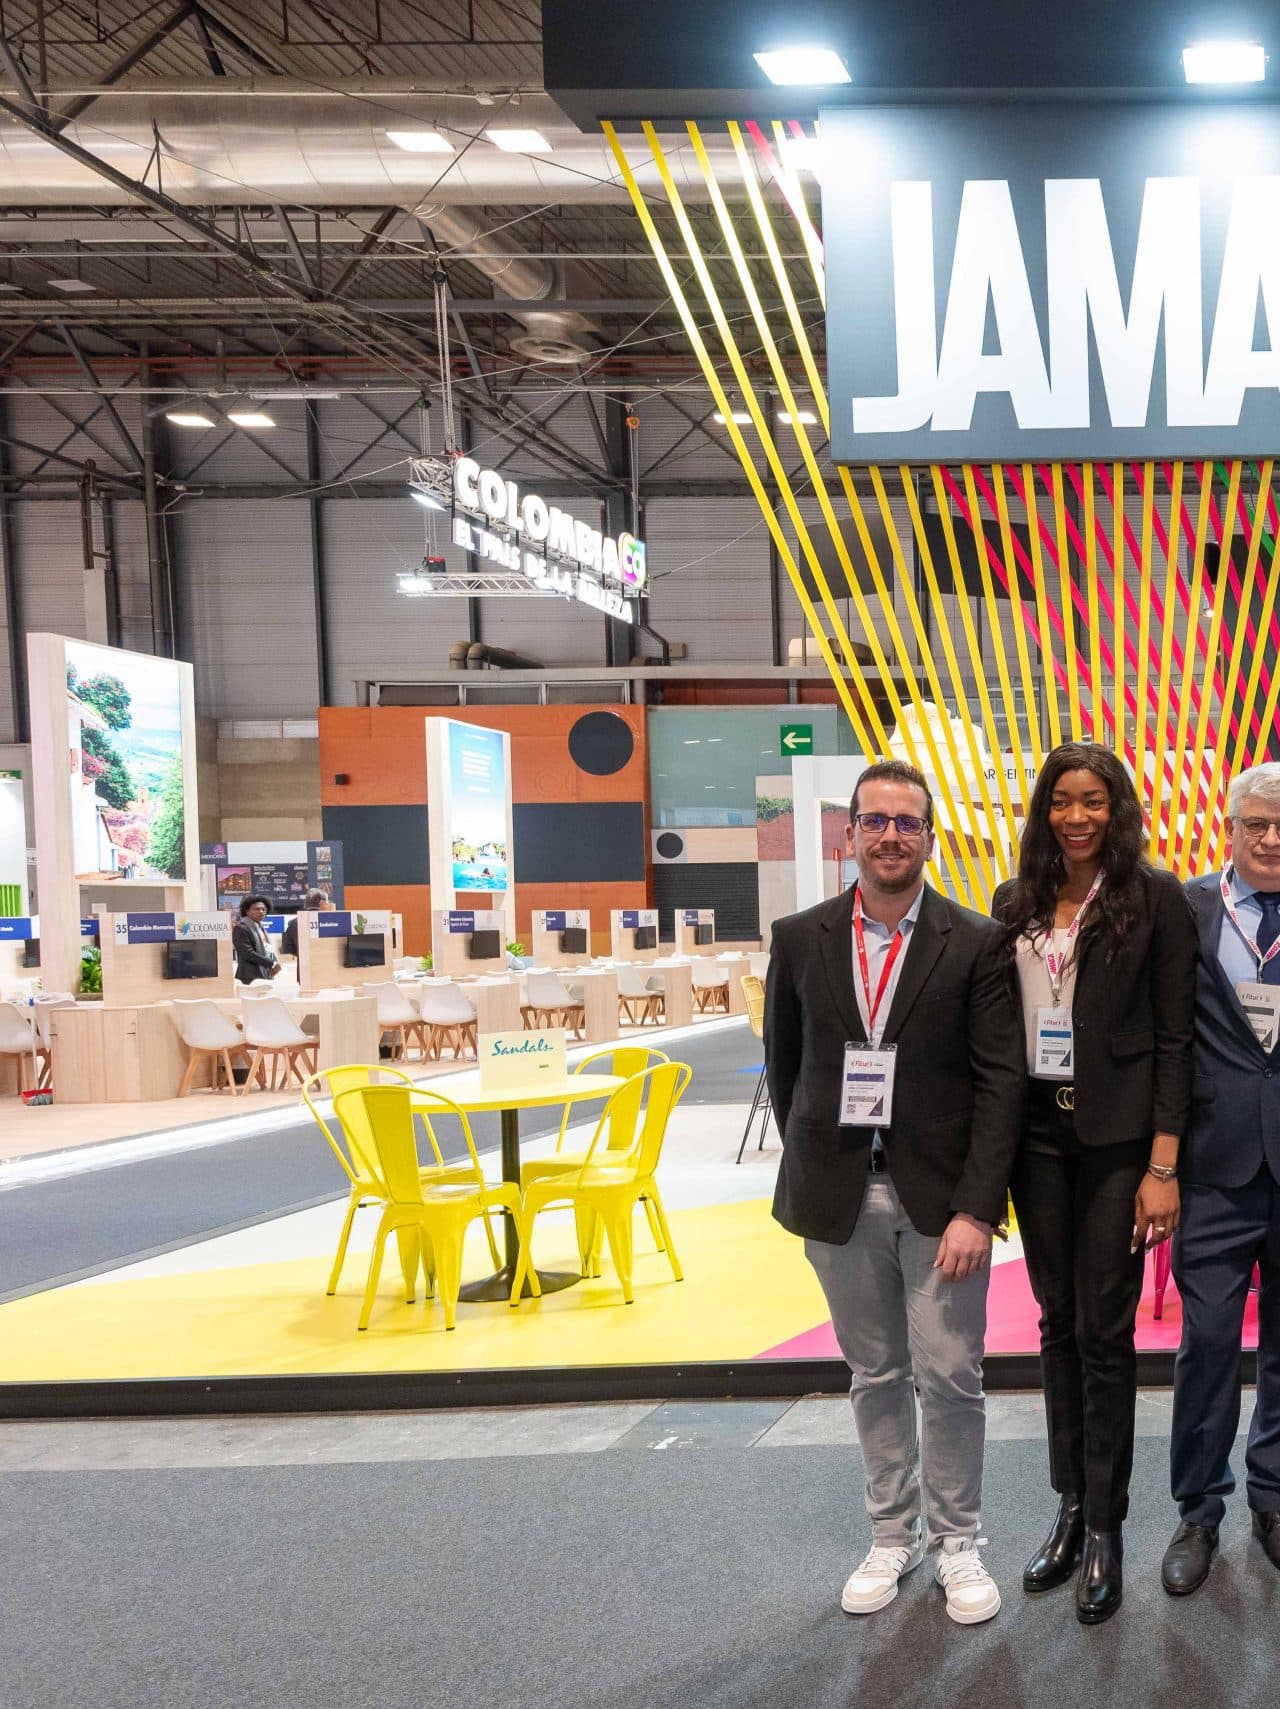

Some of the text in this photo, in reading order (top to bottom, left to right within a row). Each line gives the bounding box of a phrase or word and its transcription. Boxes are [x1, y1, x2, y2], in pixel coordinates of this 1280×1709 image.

[453, 457, 621, 581] COLOMBIA
[115, 924, 127, 934] 35
[491, 1038, 554, 1057] Sandals
